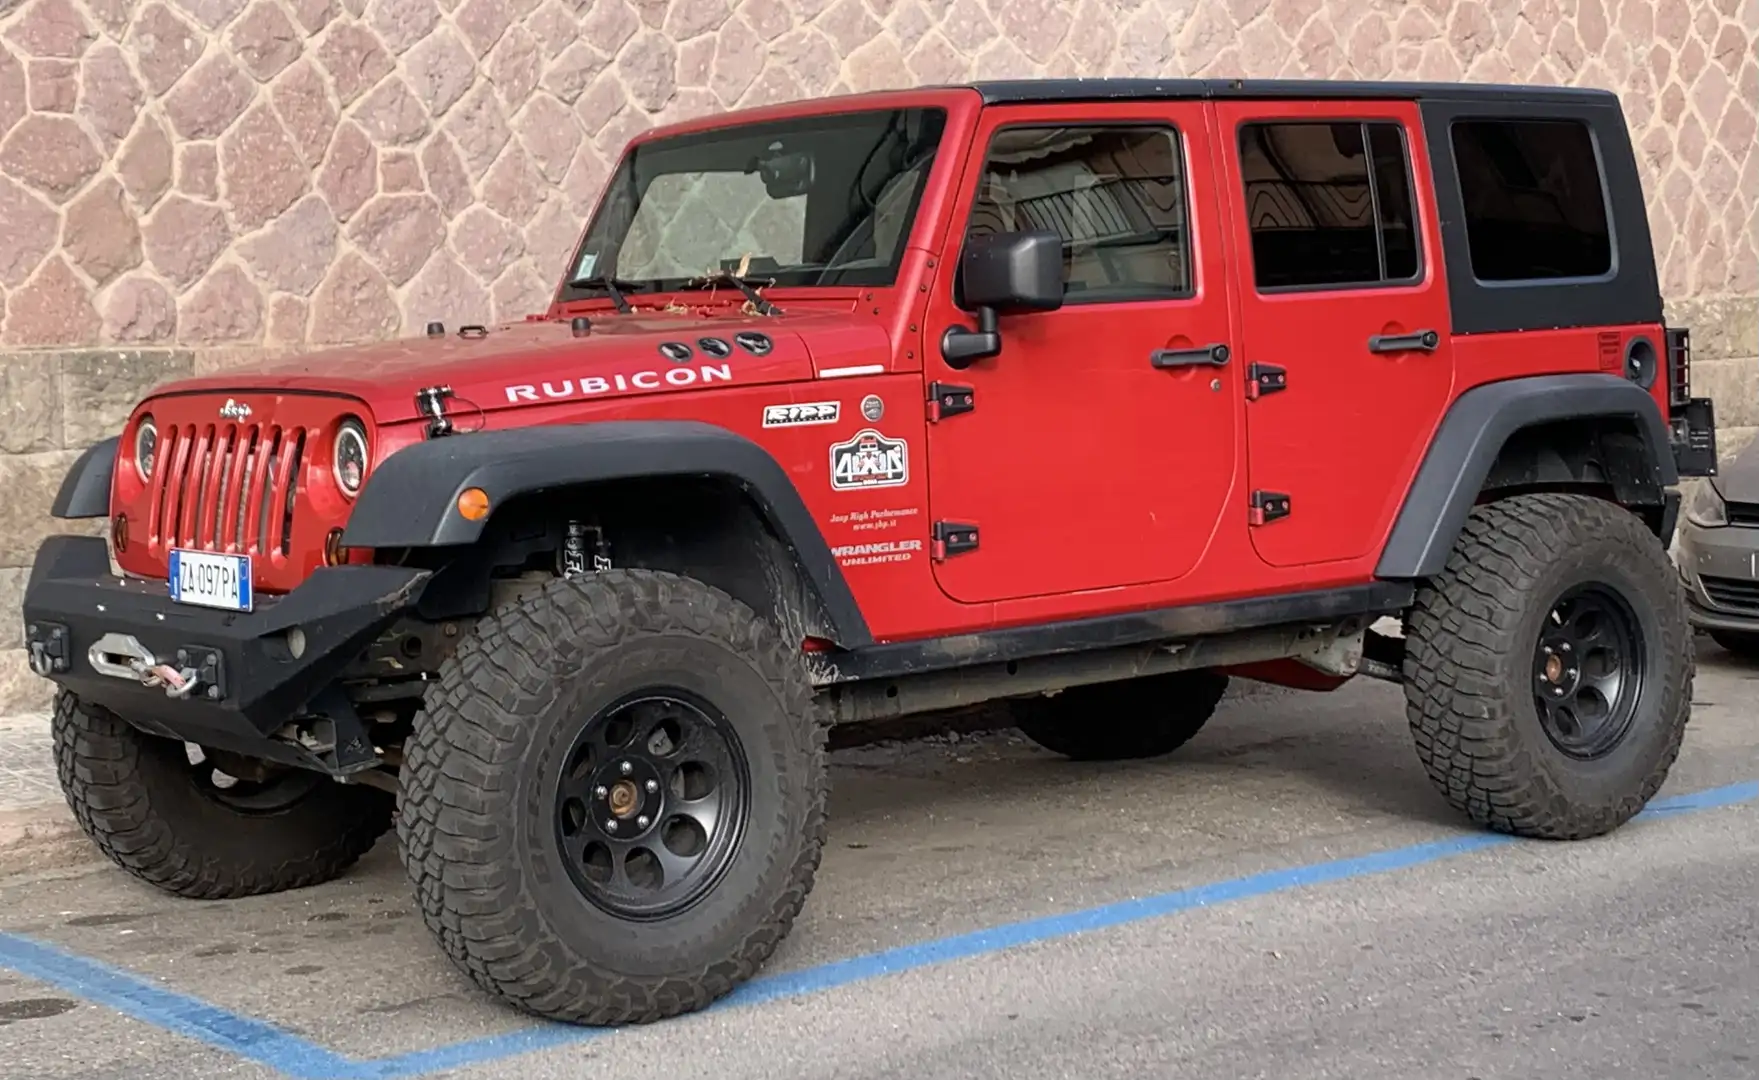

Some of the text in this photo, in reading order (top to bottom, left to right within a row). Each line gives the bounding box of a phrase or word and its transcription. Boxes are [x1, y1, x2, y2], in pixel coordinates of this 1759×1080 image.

[505, 363, 732, 403] RUBICON
[767, 405, 836, 420] RIPP
[850, 511, 869, 522] High
[870, 508, 918, 518] Performance
[842, 553, 911, 566] UNLIMITED
